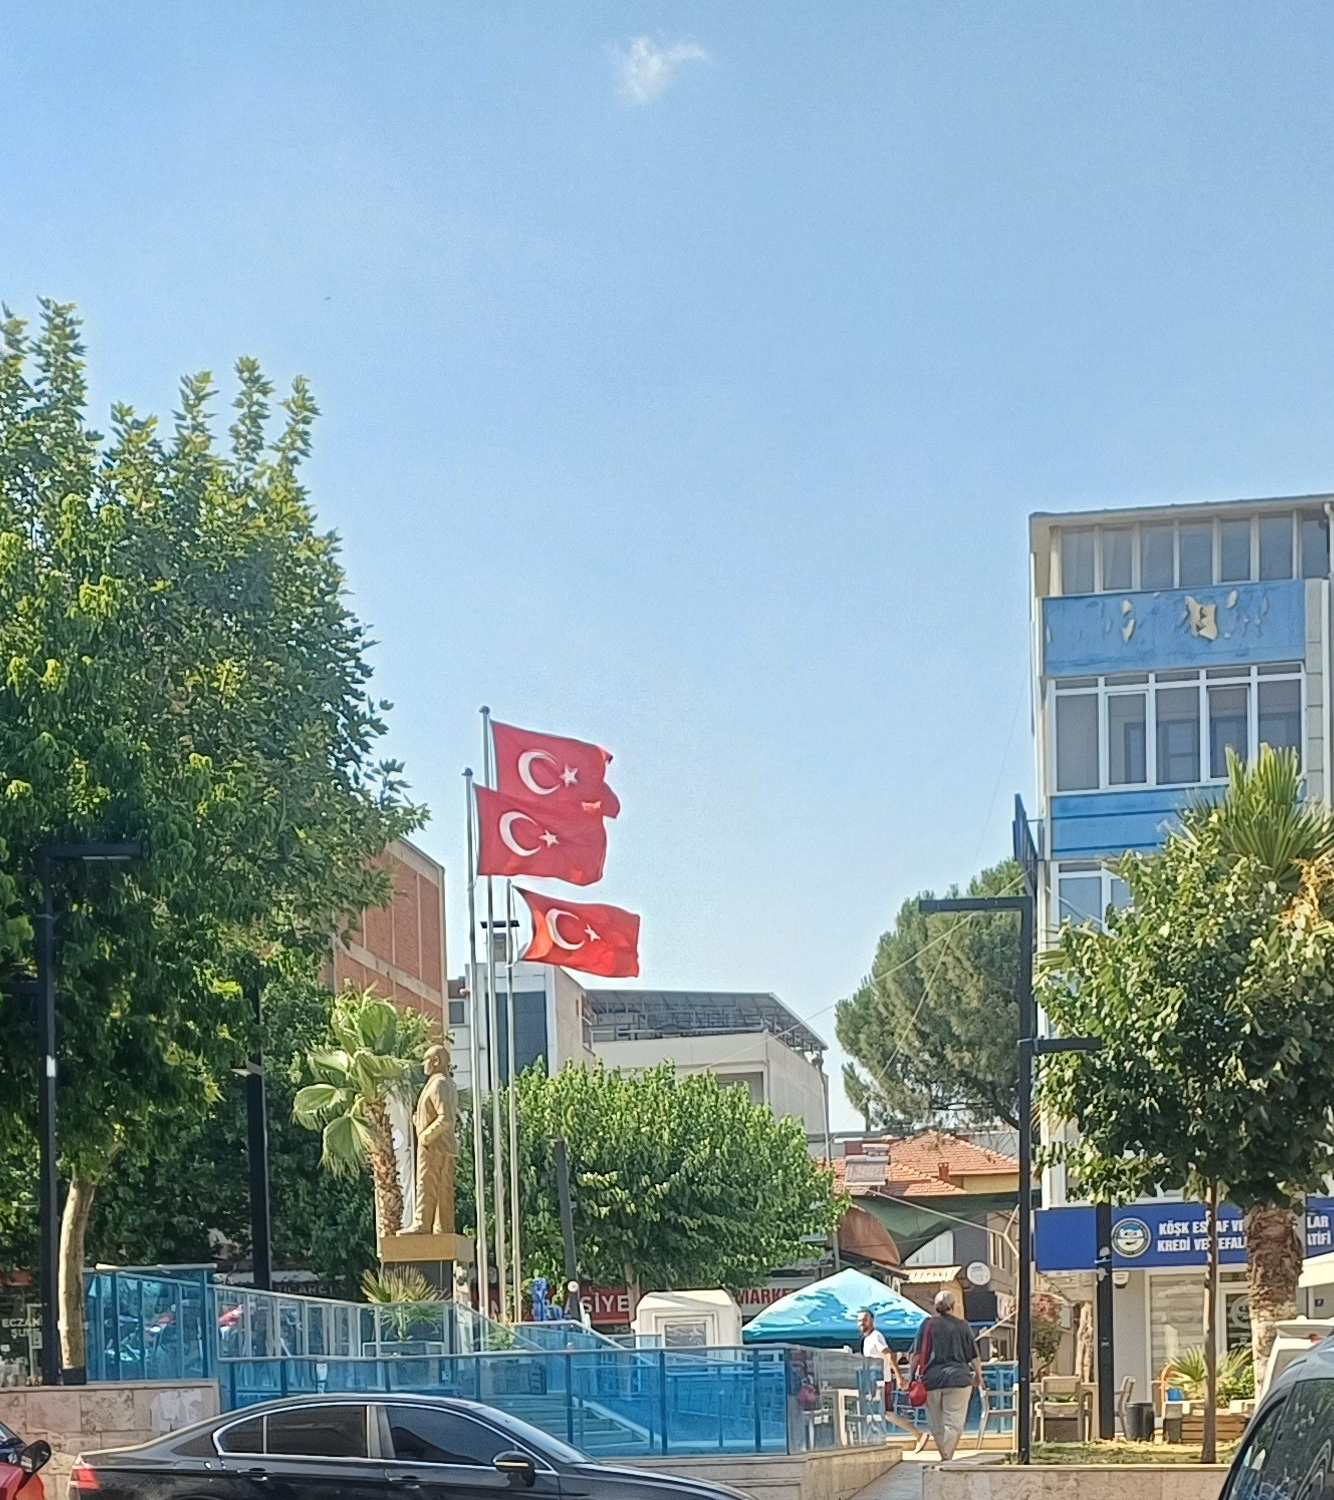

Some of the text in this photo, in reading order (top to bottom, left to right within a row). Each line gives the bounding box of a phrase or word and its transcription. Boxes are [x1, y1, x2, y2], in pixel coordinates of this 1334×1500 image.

[1158, 1219, 1189, 1237] KÖŞK
[1192, 1220, 1229, 1234] ESAF
[1157, 1236, 1191, 1252] KREDİ
